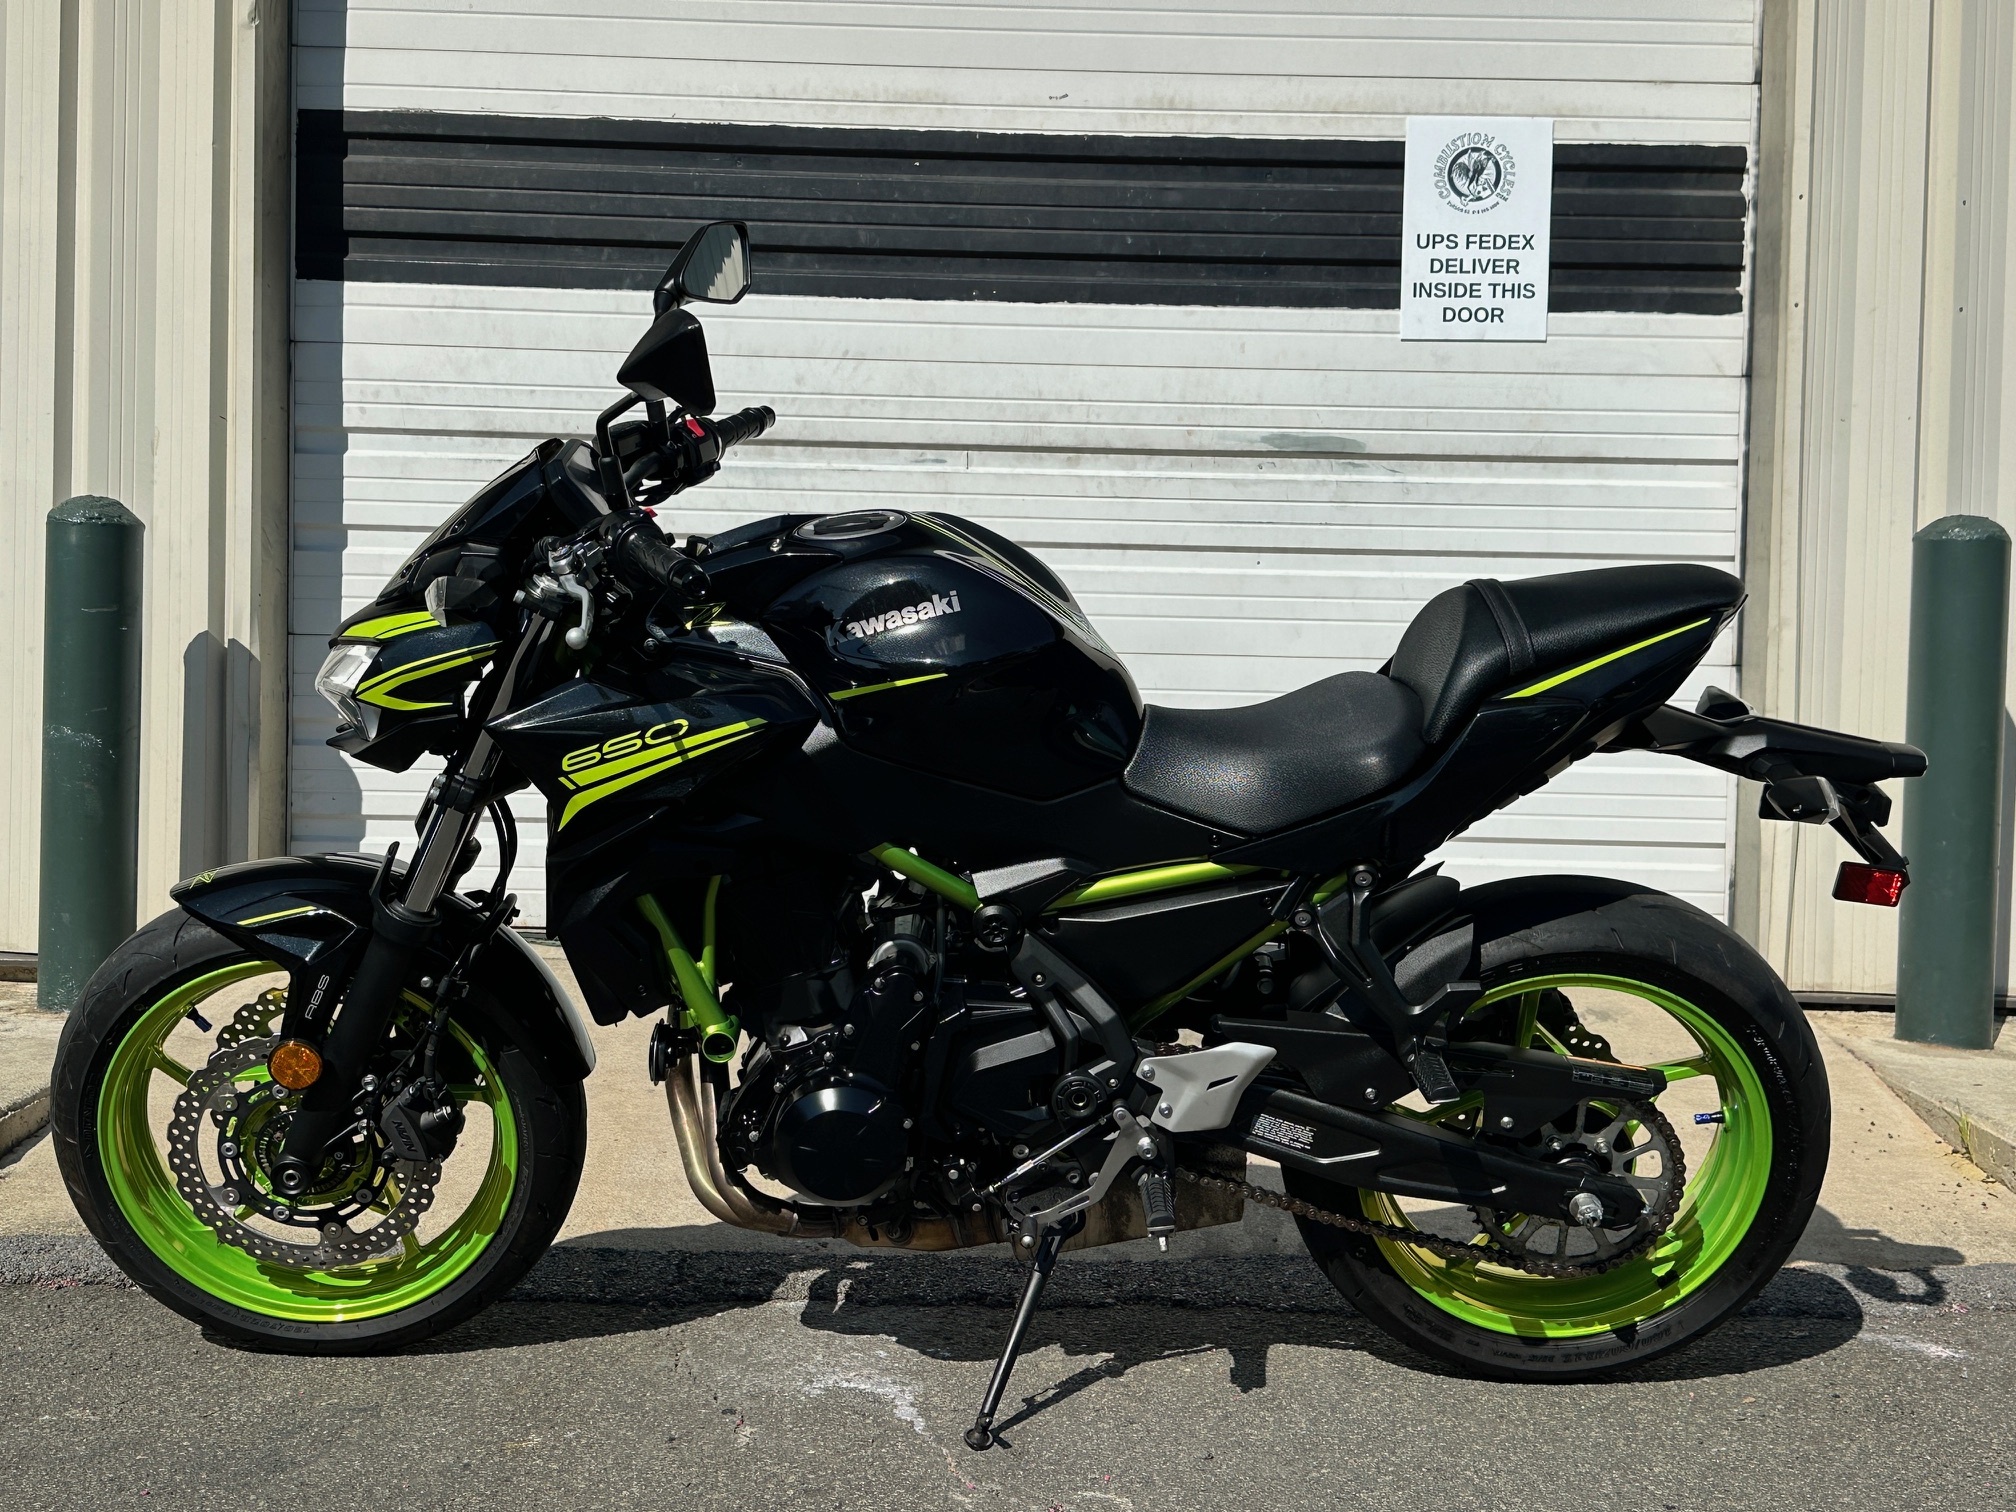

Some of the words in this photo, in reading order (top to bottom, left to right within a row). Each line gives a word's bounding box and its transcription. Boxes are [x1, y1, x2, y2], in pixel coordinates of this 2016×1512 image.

[1433, 132, 1496, 199] COMBUSTION
[1494, 143, 1516, 197] CYCLES
[1416, 233, 1459, 250] UPS
[1465, 233, 1535, 251] FEDEX
[1429, 257, 1520, 275] DELIVER
[1412, 282, 1482, 299] INSIDE
[1487, 282, 1536, 299] THIS
[1442, 306, 1505, 323] DOOR
[824, 590, 962, 647] Kawasaki
[561, 718, 689, 772] 650
[304, 974, 330, 1020] ABS
